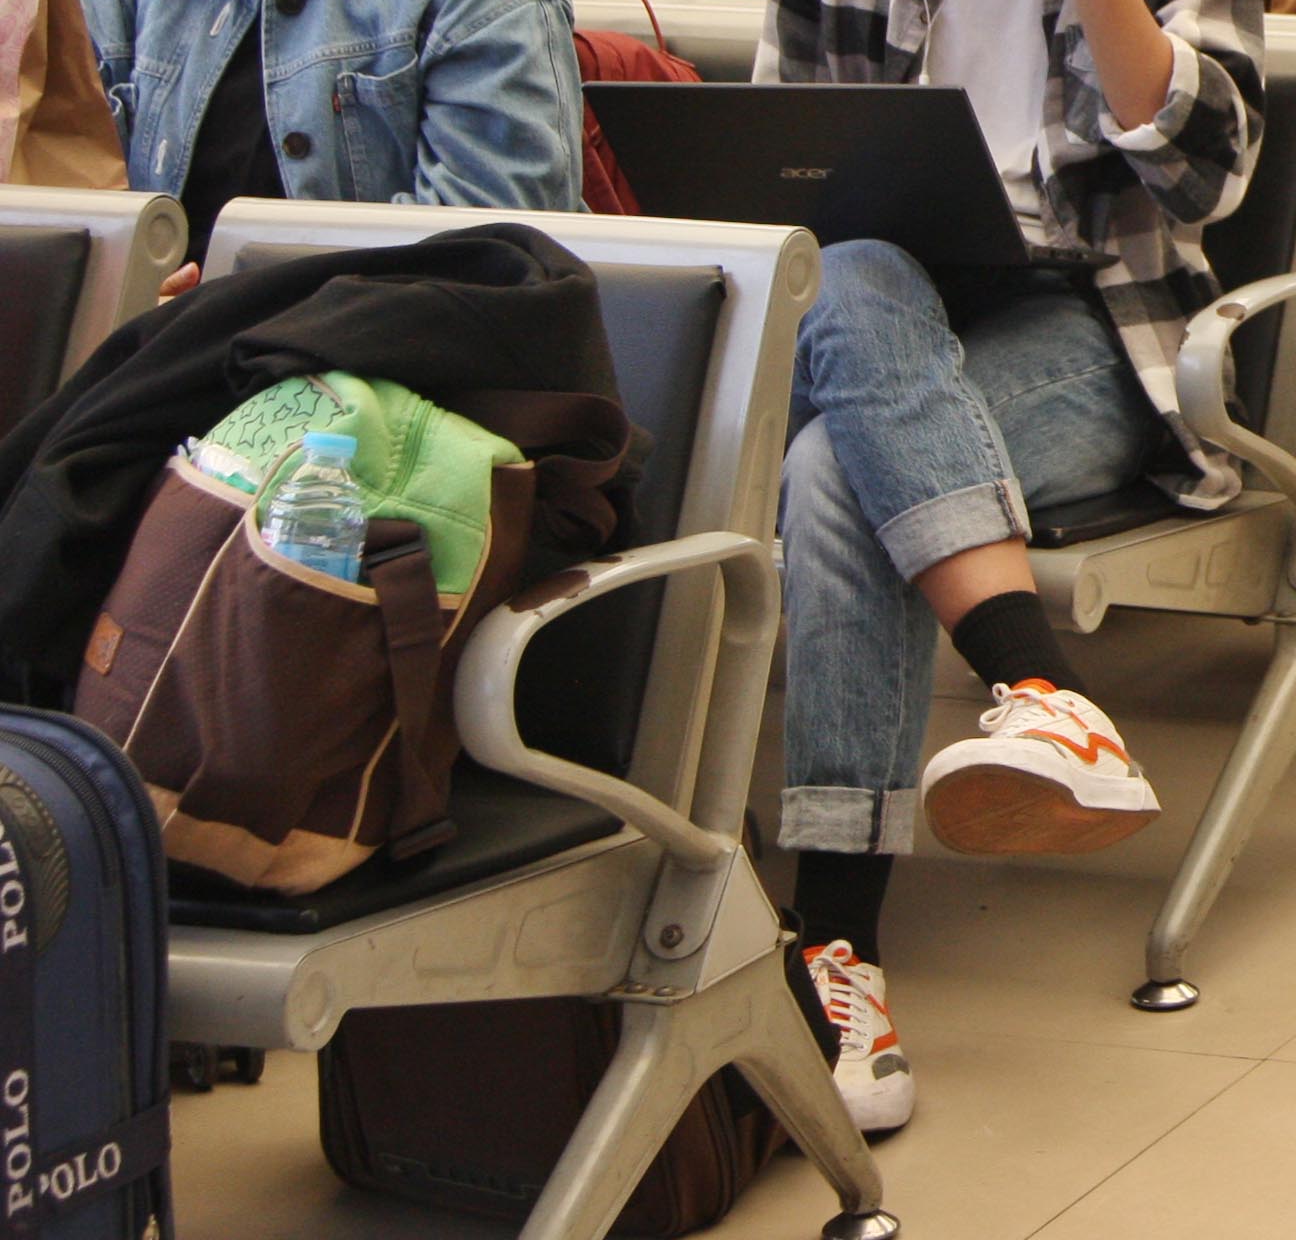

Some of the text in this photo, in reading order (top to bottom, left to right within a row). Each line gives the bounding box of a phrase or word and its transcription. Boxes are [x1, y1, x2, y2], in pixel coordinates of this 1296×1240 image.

[780, 167, 832, 179] acer
[0, 820, 28, 953] POL
[5, 1069, 32, 1218] POLO
